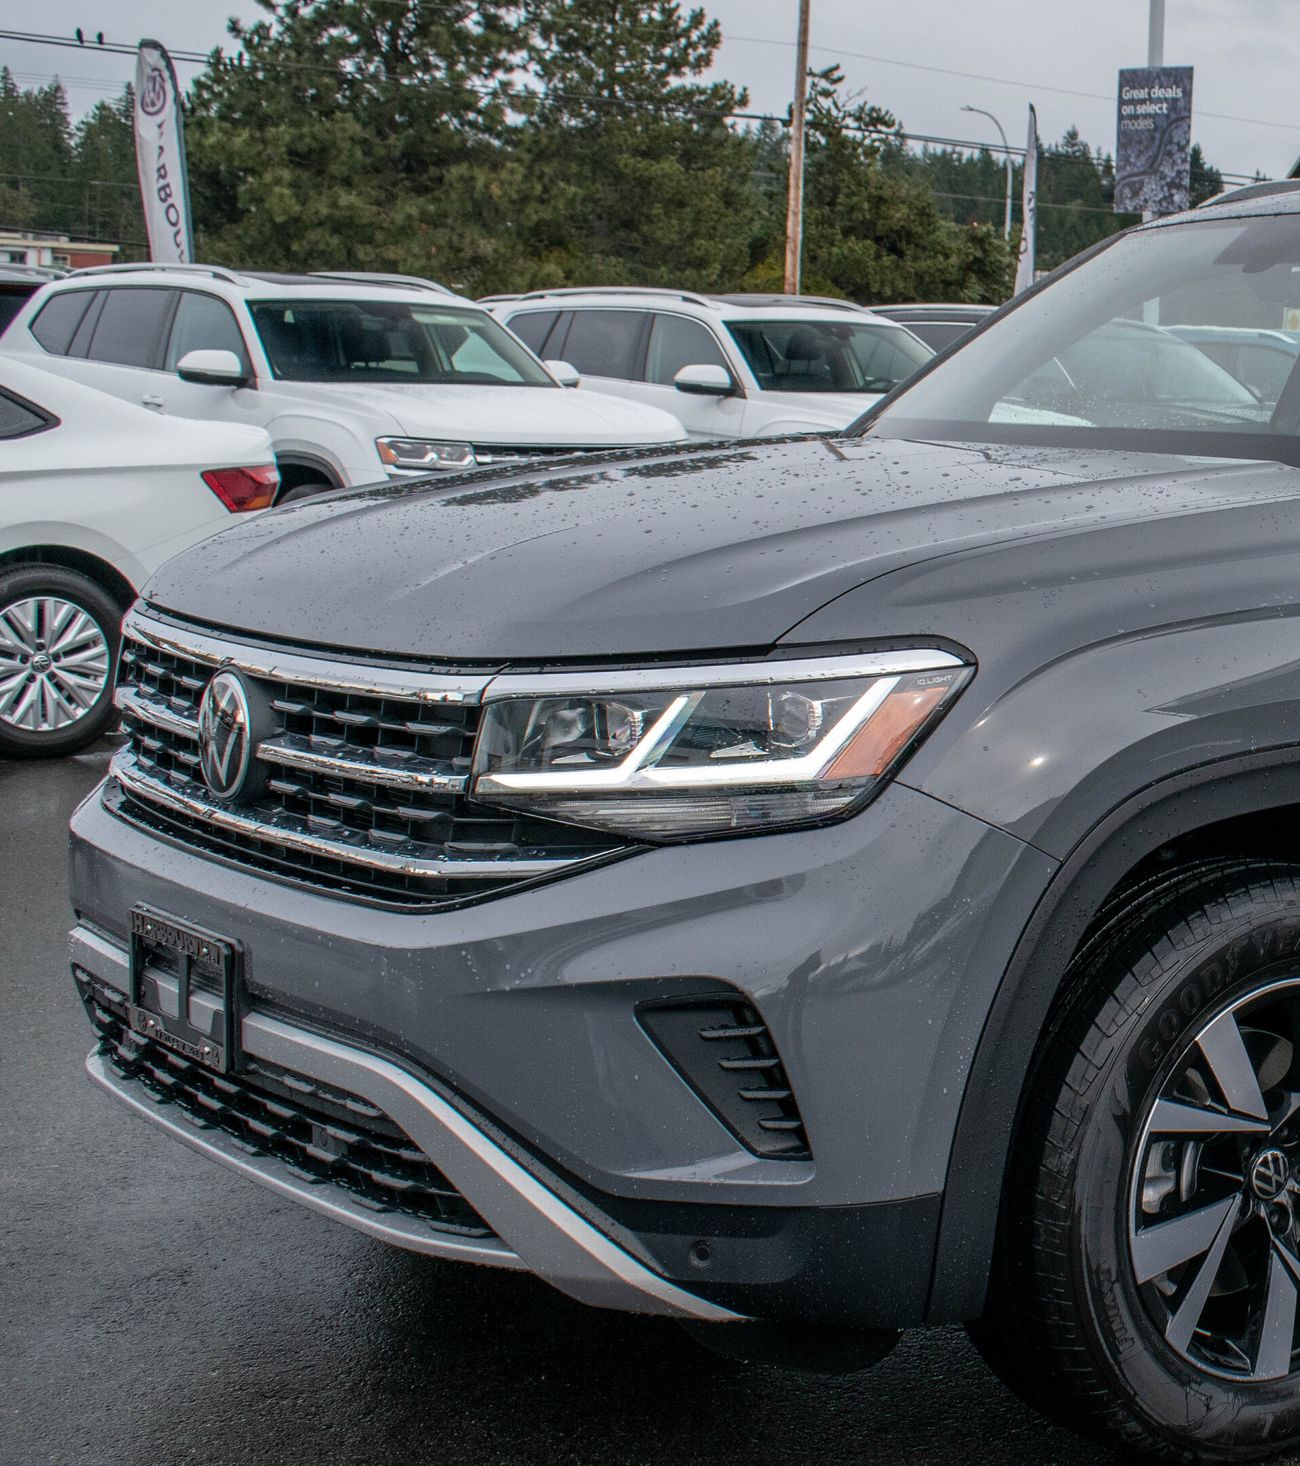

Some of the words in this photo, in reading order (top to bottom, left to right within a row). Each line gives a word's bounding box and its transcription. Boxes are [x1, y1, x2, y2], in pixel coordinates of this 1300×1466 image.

[1122, 86, 1149, 100] Great
[1150, 85, 1183, 98] deals
[1121, 104, 1135, 115] on
[1136, 102, 1168, 114] select
[1121, 118, 1155, 130] models
